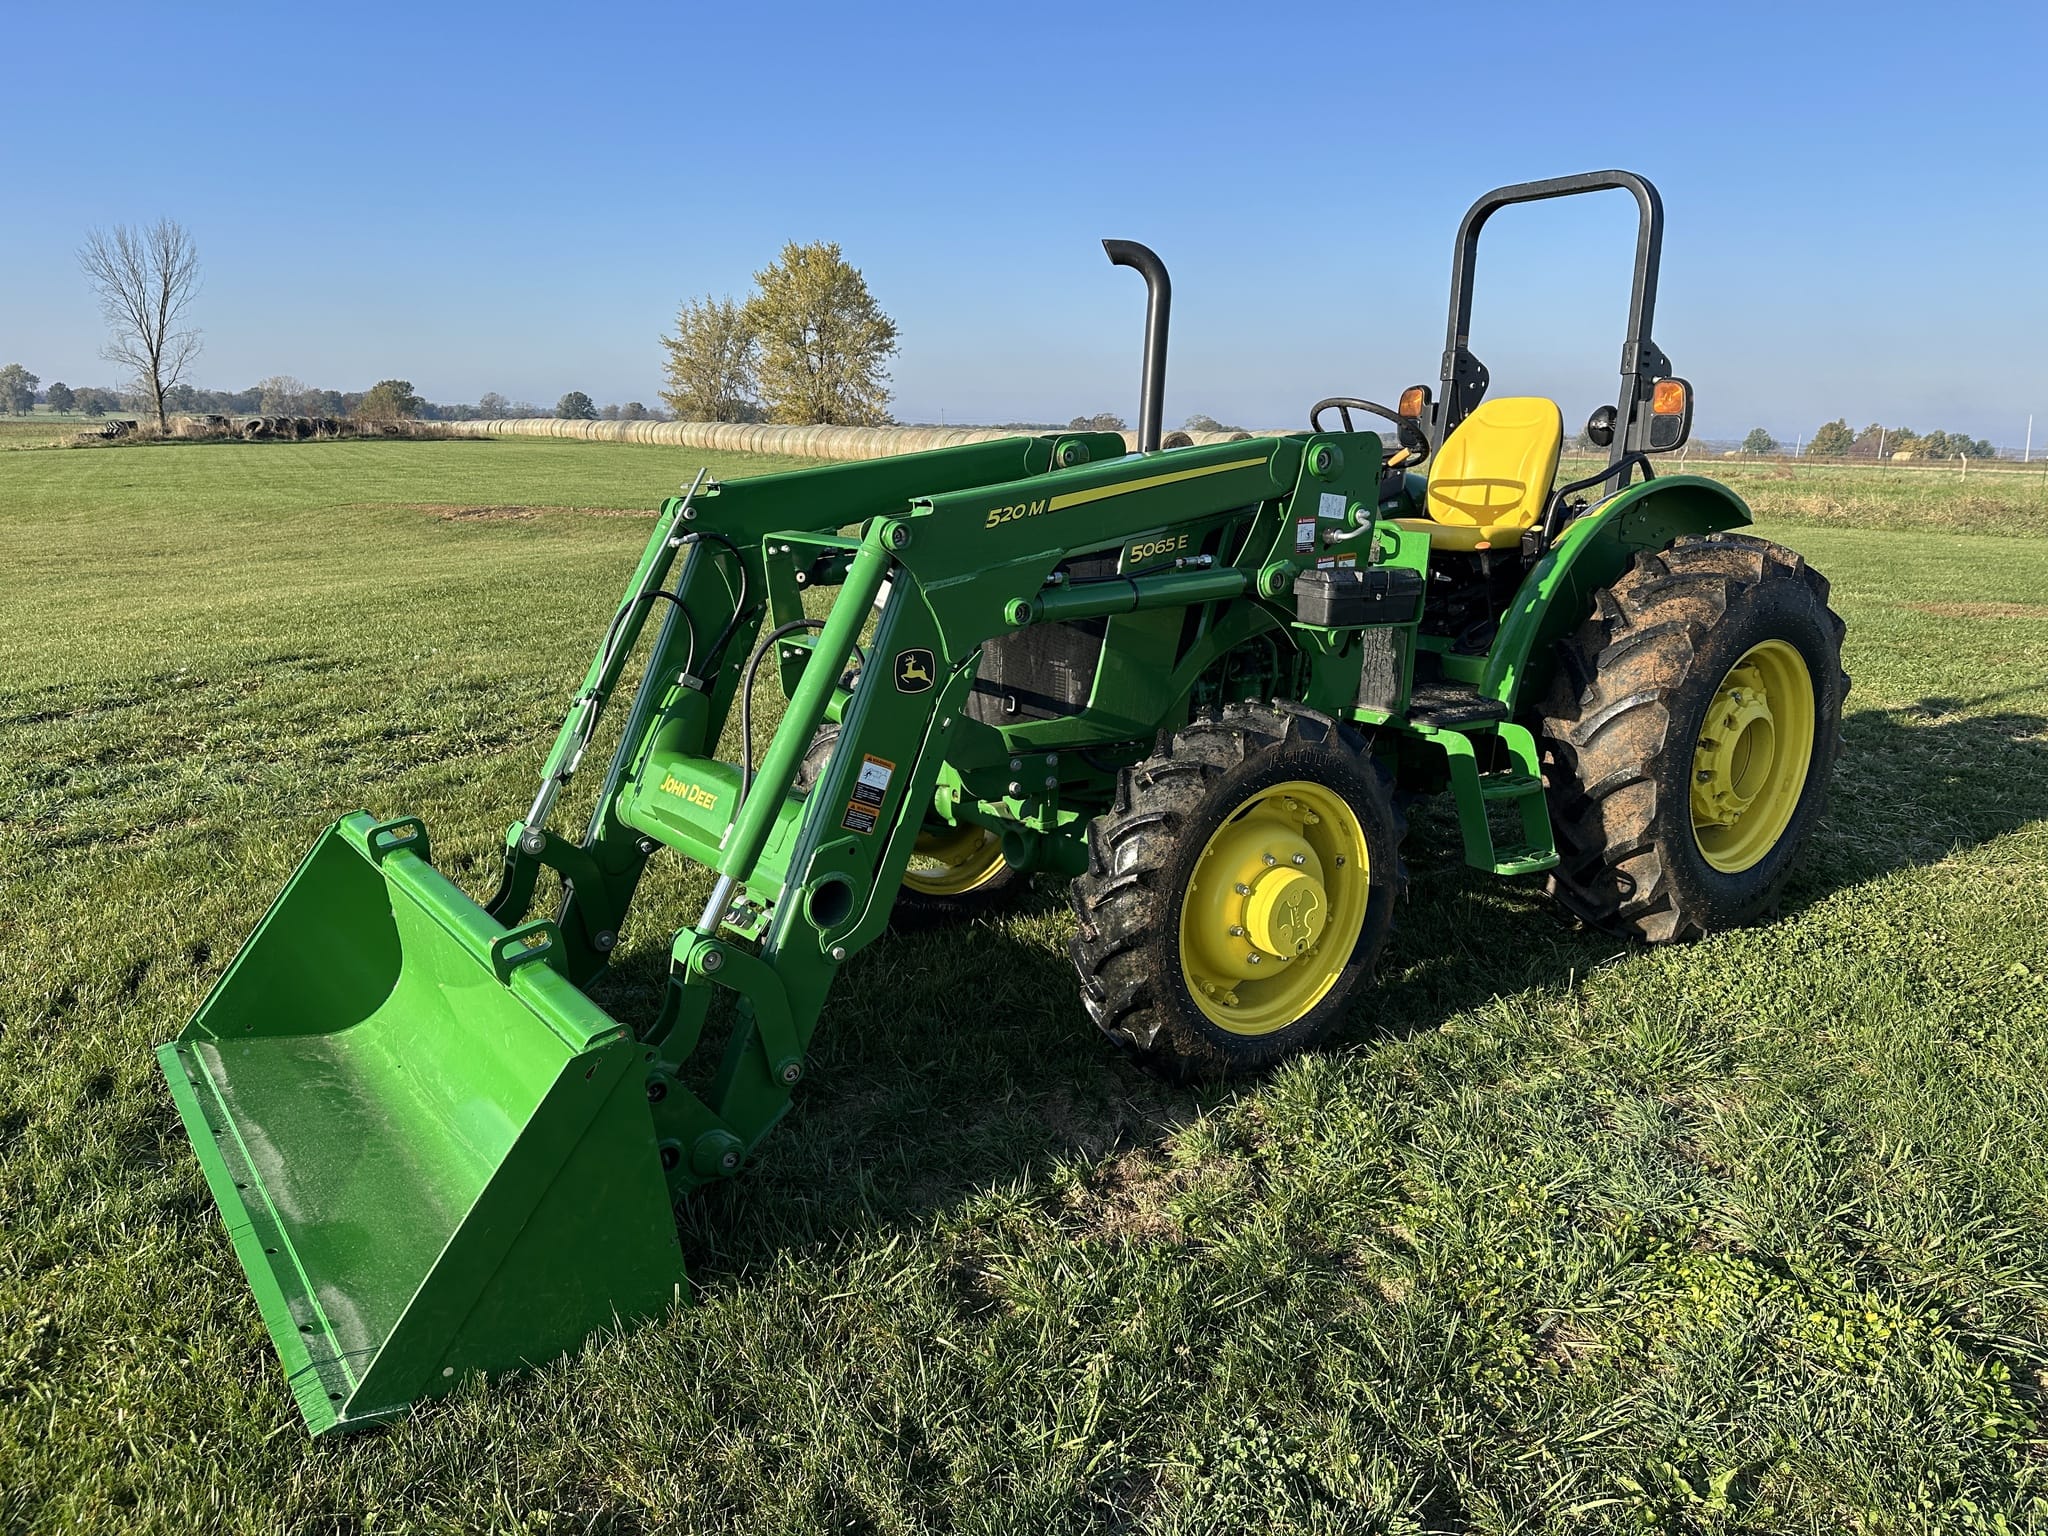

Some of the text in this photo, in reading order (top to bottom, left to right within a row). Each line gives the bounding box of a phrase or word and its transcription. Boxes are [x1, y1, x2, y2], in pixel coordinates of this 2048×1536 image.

[985, 499, 1046, 529] 520 M
[1129, 535, 1189, 564] 5065 E
[660, 774, 690, 799] JOHN
